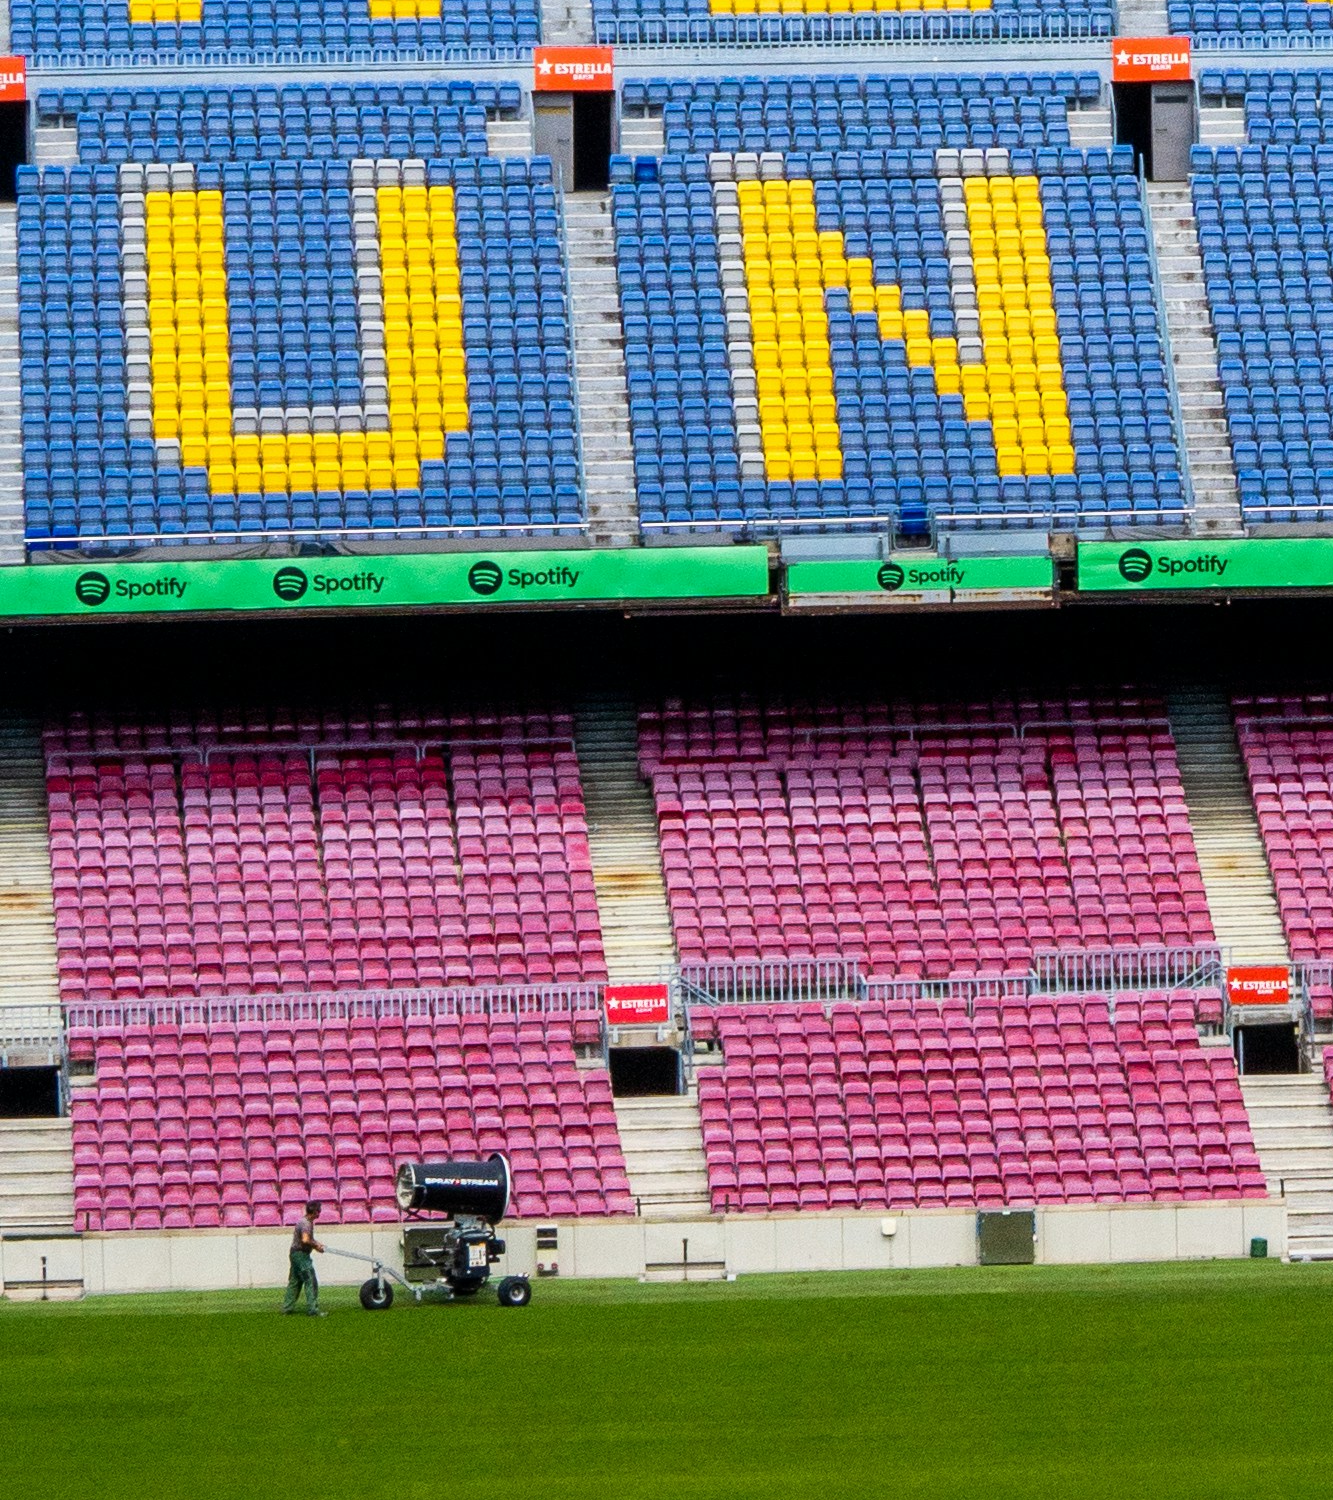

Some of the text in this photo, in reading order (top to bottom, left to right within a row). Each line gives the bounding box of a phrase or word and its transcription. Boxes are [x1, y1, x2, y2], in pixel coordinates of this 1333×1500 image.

[554, 63, 612, 75] ESTRELLA
[1132, 53, 1189, 65] ESTRELLA
[1158, 554, 1227, 576] Spotify
[114, 575, 186, 599] Spotify
[312, 570, 384, 594] Spotify
[508, 566, 579, 588] Spotify
[908, 567, 963, 587] Spotify
[1243, 980, 1288, 991] ESTRELLA
[621, 998, 666, 1010] ESTRELLA
